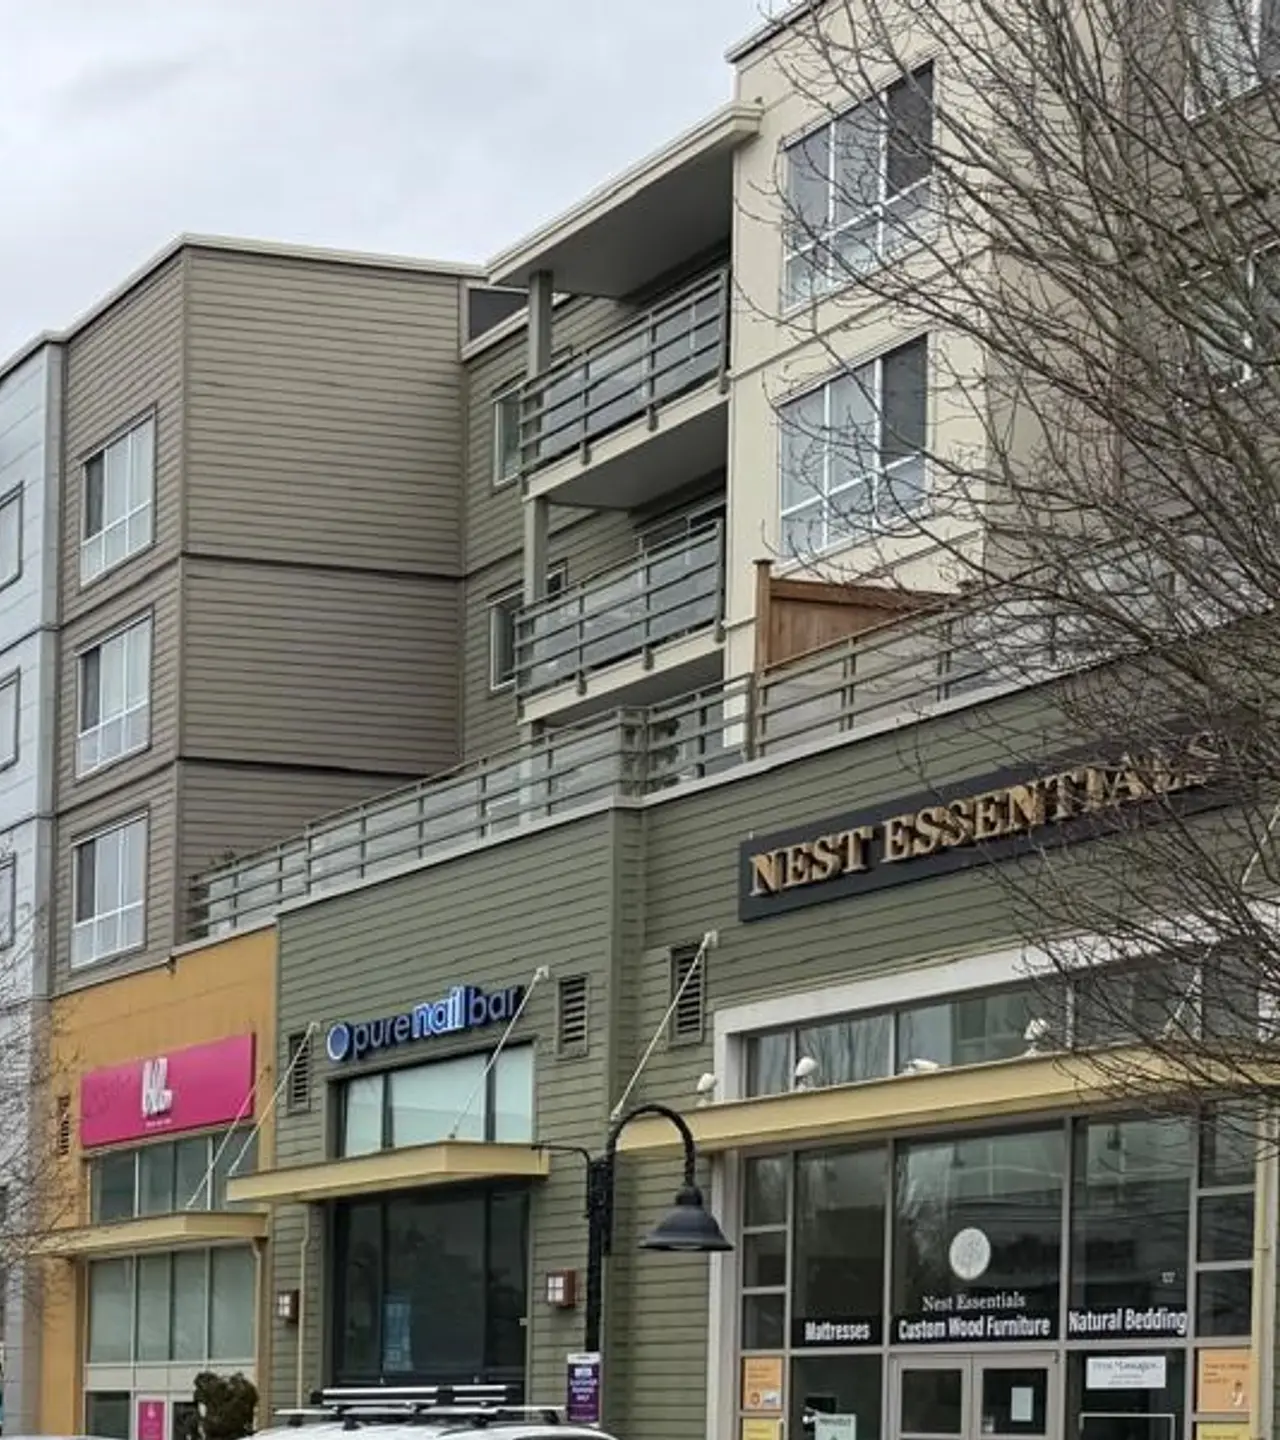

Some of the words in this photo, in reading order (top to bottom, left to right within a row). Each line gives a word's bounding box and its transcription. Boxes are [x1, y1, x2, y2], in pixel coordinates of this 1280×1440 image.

[750, 825, 872, 896] NEST
[922, 1296, 953, 1312] Nest
[956, 1291, 1026, 1311] Essentials
[805, 1321, 871, 1341] Mattresses
[898, 1319, 946, 1340] Custom
[948, 1315, 984, 1338] Wood
[987, 1314, 1050, 1337] Furniture
[1068, 1307, 1123, 1333] Natural
[1124, 1306, 1188, 1335] Bedding
